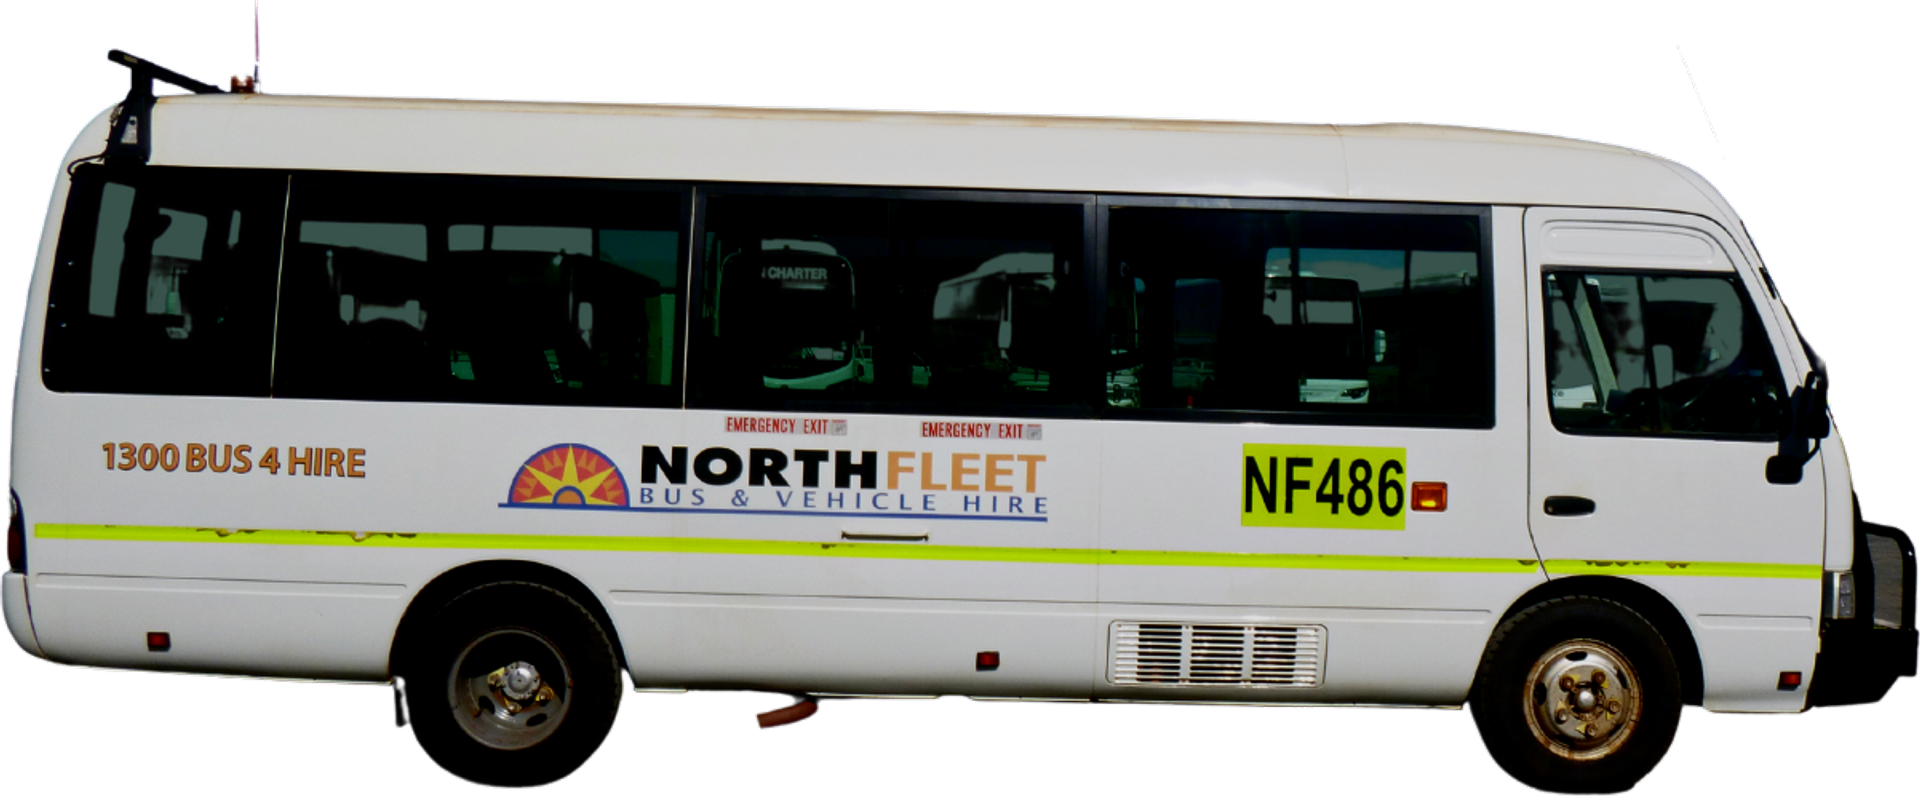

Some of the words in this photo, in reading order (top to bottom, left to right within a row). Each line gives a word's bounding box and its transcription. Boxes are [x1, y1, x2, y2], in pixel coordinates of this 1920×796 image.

[768, 266, 828, 281] CHARTER
[726, 416, 796, 434] EMERGENCY
[803, 418, 829, 434] EXIT
[922, 421, 991, 439] EMERGENCY
[998, 423, 1023, 439] EXIT
[102, 442, 179, 472] 1300
[185, 442, 252, 474] BUS
[258, 446, 281, 475] 4
[287, 446, 366, 478] HIRE
[1245, 455, 1405, 517] NF486
[640, 487, 706, 507] BUS
[731, 489, 750, 508] &
[776, 490, 936, 513] VEHICLE
[963, 495, 1048, 515] HIRE
